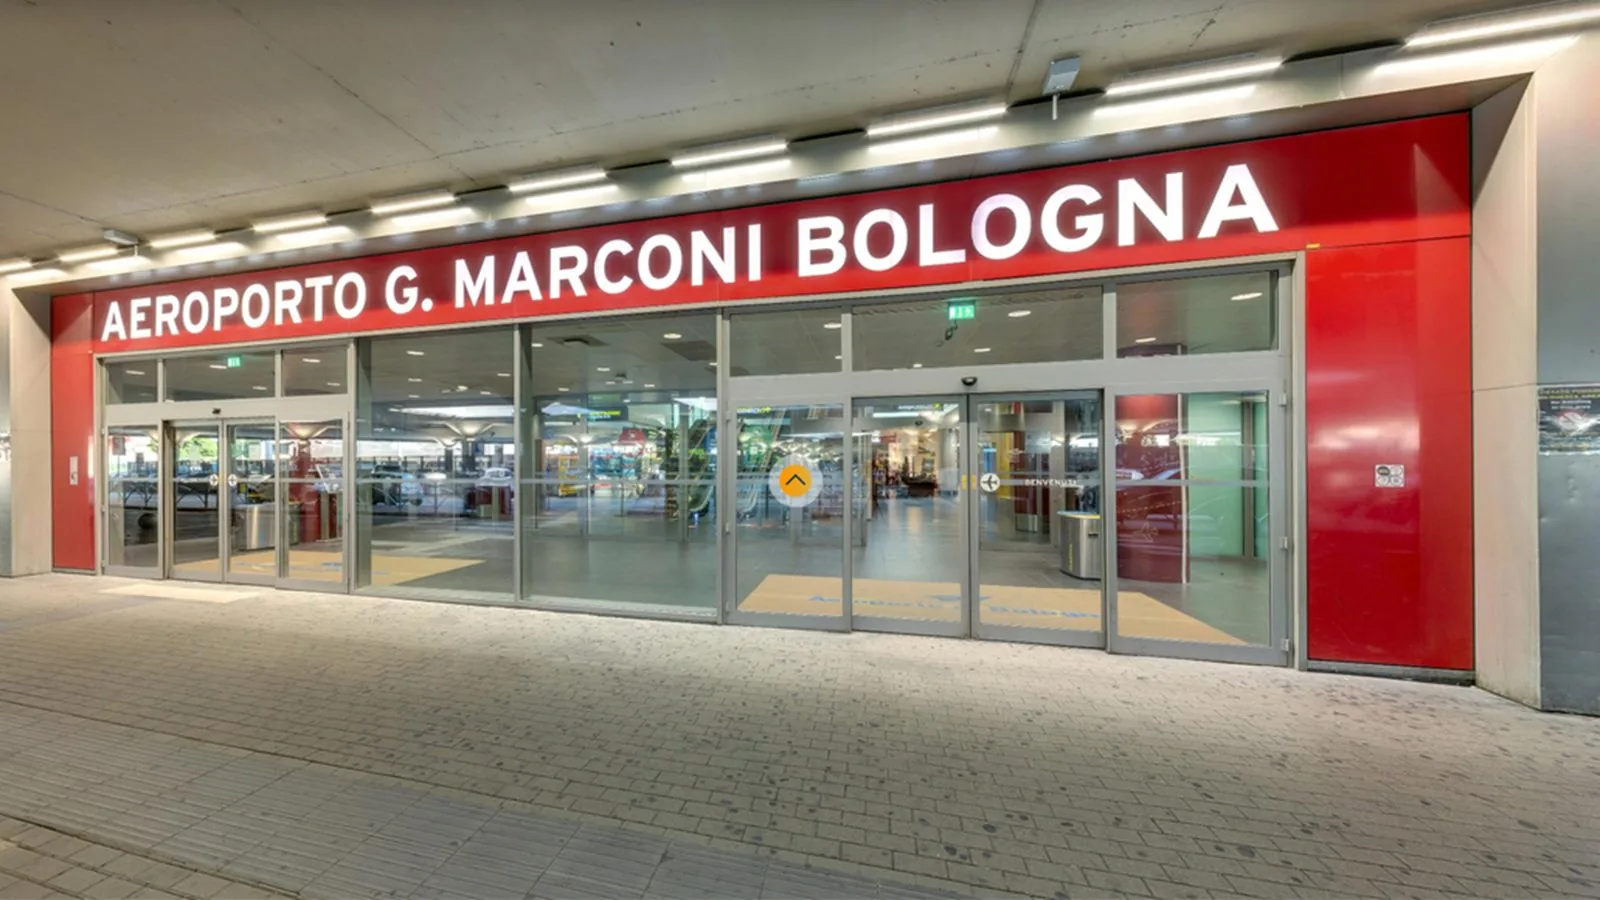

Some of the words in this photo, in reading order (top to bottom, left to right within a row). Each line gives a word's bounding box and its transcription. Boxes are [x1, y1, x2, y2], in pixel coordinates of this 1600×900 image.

[101, 271, 367, 342] AEROPORTO
[384, 265, 434, 315] G.
[454, 225, 763, 309] MARCONI
[797, 163, 1280, 278] BOLOGNA
